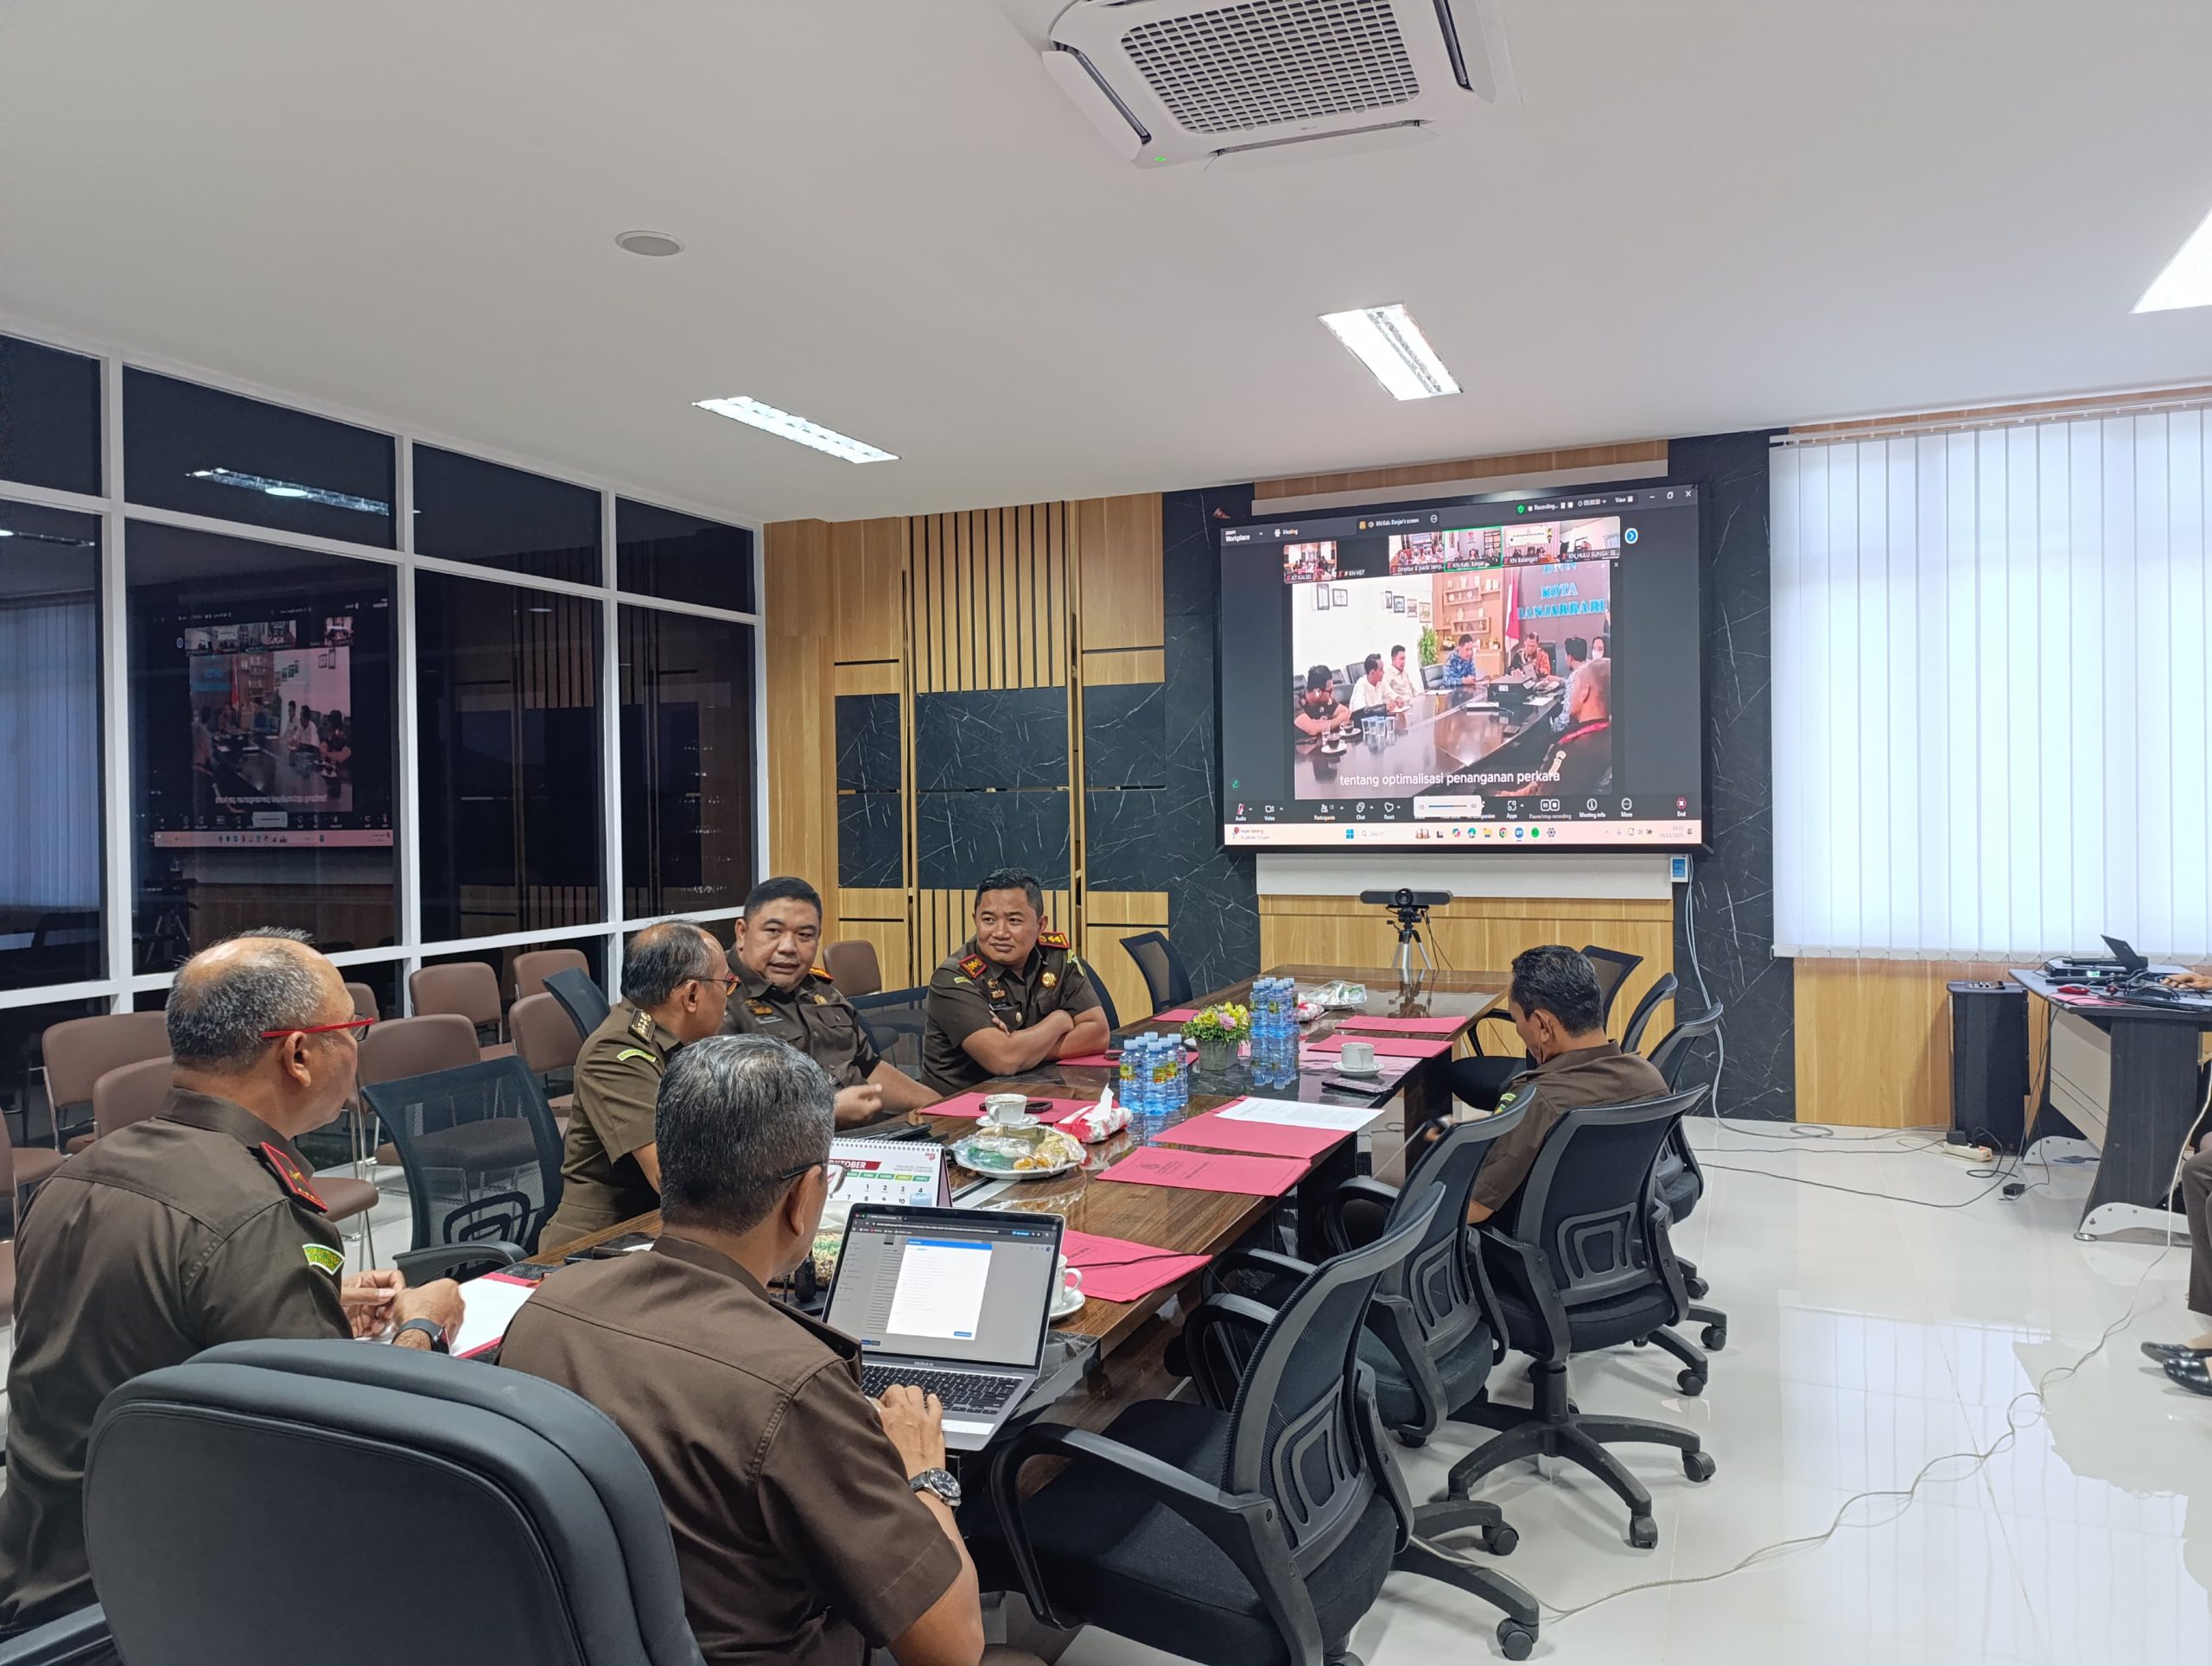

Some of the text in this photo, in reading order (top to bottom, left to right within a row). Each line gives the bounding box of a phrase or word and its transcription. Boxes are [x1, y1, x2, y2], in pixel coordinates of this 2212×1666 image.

[1225, 534, 1250, 543] Workplace
[1541, 582, 1579, 599] KOTA
[1340, 770, 1560, 787] tentang optimalisasi penanganan perkara
